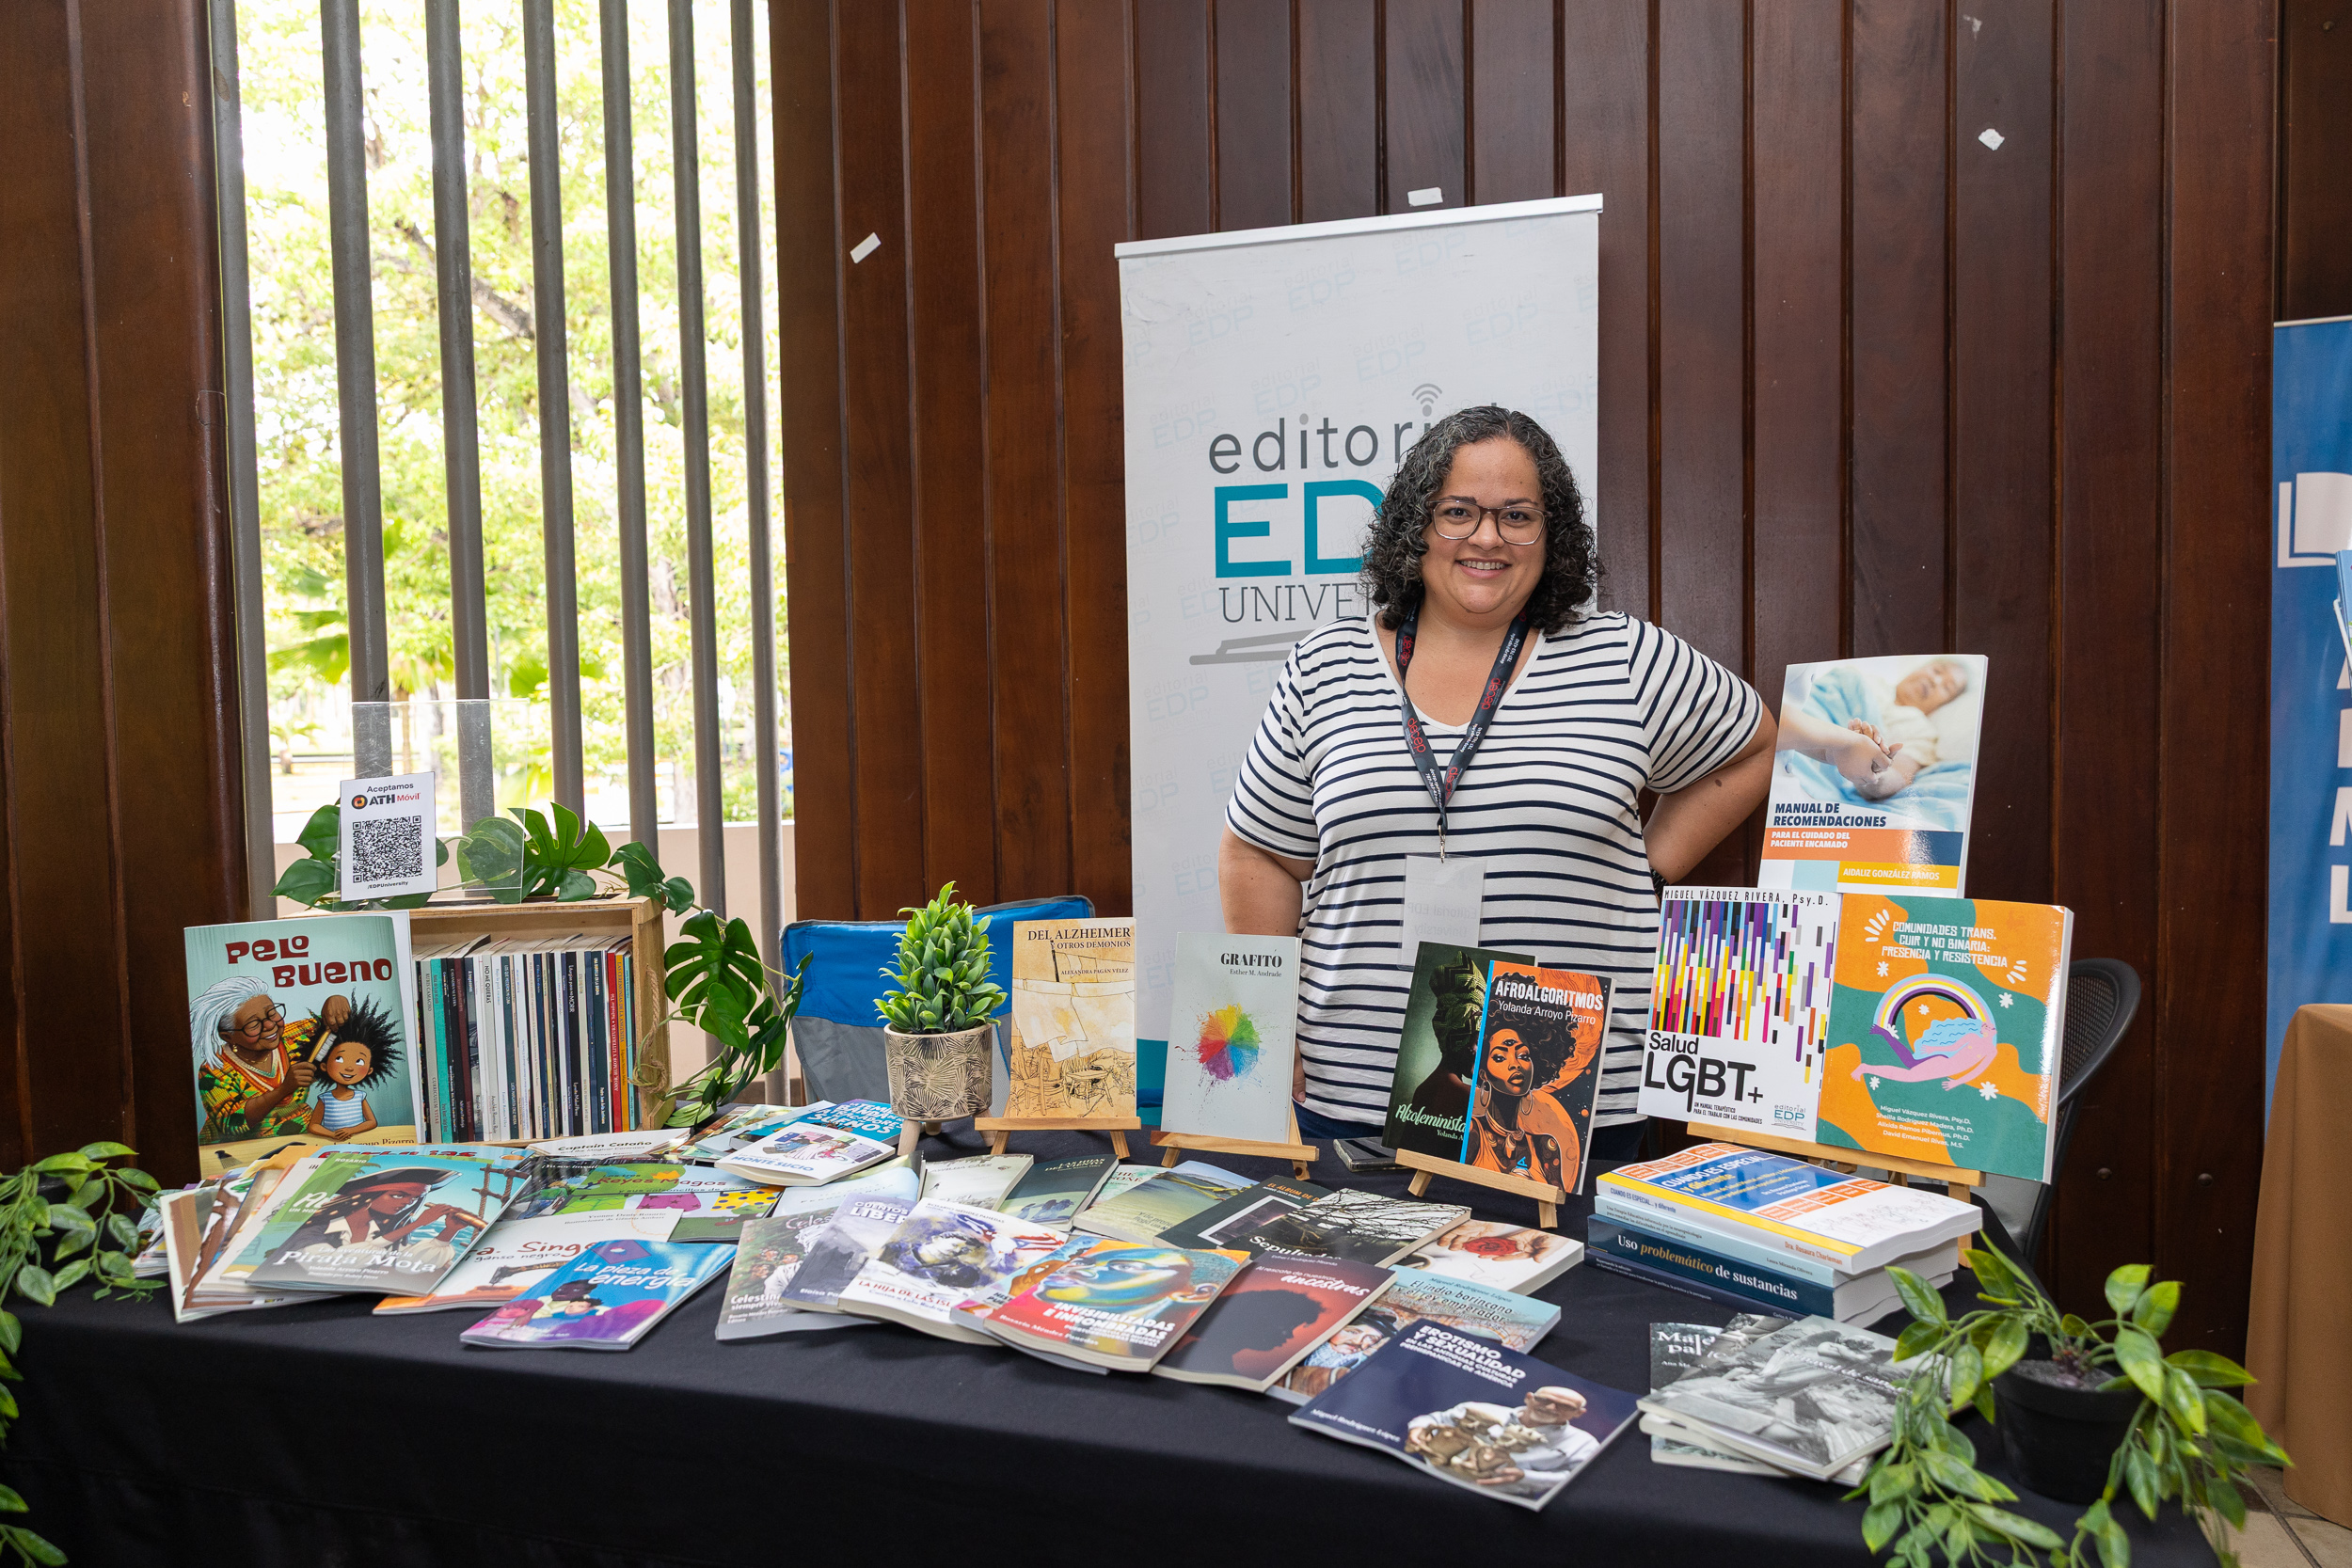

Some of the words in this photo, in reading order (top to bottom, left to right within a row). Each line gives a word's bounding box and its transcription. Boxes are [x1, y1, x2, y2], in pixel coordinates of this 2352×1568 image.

[1287, 269, 1356, 312] EDP
[1356, 340, 1426, 382] EDP
[1255, 374, 1321, 416] EDP
[1209, 404, 1444, 473] editori
[1215, 479, 1389, 578] ED
[1481, 677, 1501, 709] decep
[1147, 685, 1210, 723] EDP
[1407, 718, 1425, 752] decep
[367, 784, 414, 793] Aceptamos
[369, 794, 395, 805] ATH
[397, 793, 420, 801] Móvil
[1775, 803, 1822, 813] MANUAL
[1824, 803, 1839, 813] DE
[1773, 816, 1886, 827] RECOMENDACIONES
[1843, 868, 1871, 877] AIDALIZ
[1872, 868, 1910, 879] GONZÁLEZ
[1912, 871, 1939, 879] RAMOS
[1665, 890, 1693, 899] MIGUEL
[1700, 889, 1738, 901] VÁZQUEZ
[1028, 930, 1052, 940] DEL
[1056, 927, 1131, 939] ALZHEIMER
[1893, 922, 1957, 937] COMUNIDADES
[1899, 935, 1920, 946] CUIR
[1924, 937, 1929, 946] Y
[1931, 939, 1945, 948] NO
[1947, 940, 1990, 952] BINARIA:
[1882, 946, 1931, 960] PRESENCIA
[1934, 951, 1940, 960] Y
[1943, 951, 2008, 968] RESISTENCIA
[485, 965, 489, 974] NO
[1495, 980, 1603, 1011] AFROALGORITMOS
[1498, 1000, 1533, 1015] Yolanda
[1534, 1006, 1563, 1021] Arroyo
[1565, 1010, 1596, 1024] Pizarro
[1649, 1032, 1699, 1054] Salud
[1714, 1104, 1736, 1113] TERAPÉUTICO
[1774, 1104, 1805, 1113] editorial
[1774, 1110, 1804, 1121] EDP
[1902, 1108, 1928, 1117] Vázquez
[807, 1114, 892, 1133] SUEÑOS
[1739, 1116, 1763, 1124] COMUNIDADES
[1897, 1116, 1929, 1126] Rodríguez
[1437, 1130, 1457, 1139] Yolanda
[1901, 1133, 1930, 1142] Emanuel
[558, 1143, 604, 1151] Captain
[731, 1156, 772, 1166] MONTE
[776, 1160, 814, 1172] SUCIO
[597, 1177, 653, 1185] Reyes
[1661, 1169, 1707, 1187] CUANDO
[1708, 1164, 1721, 1176] ES
[1689, 1174, 1737, 1190] diferente
[1277, 1185, 1301, 1196] ÁLBUM
[1610, 1187, 1626, 1196] CUANDO
[854, 1201, 908, 1214] CUENTOS
[336, 1247, 388, 1256] aventuras
[475, 1254, 515, 1262] ganso
[1795, 1244, 1815, 1256] Rosaura
[273, 1251, 356, 1267] Pirata
[370, 1254, 437, 1273] Mota
[575, 1262, 595, 1273] La
[601, 1265, 651, 1275] pieza
[652, 1264, 678, 1275] de
[1618, 1234, 1638, 1250] Uso
[1640, 1243, 1713, 1275] problemático
[1715, 1265, 1730, 1278] de
[1732, 1272, 1798, 1300] sustancias
[588, 1273, 695, 1290] energía
[1281, 1275, 1370, 1296] ancestras
[872, 1283, 898, 1293] HIJA
[899, 1287, 914, 1296] DE
[915, 1291, 933, 1302] LAS
[1421, 1291, 1438, 1301] rey
[1423, 1282, 1453, 1295] indio
[1454, 1291, 1513, 1314] borincano
[1043, 1308, 1053, 1317] E
[1055, 1310, 1168, 1339] INNOMBRADAS
[1054, 1302, 1176, 1332] INVISIBILIZADAS
[1419, 1325, 1502, 1359] EROTISMO
[1414, 1331, 1425, 1340] Y
[1425, 1336, 1526, 1379] SEXUALIDAD
[1418, 1340, 1433, 1350] LAS
[1434, 1345, 1474, 1366] ANTIGUAS
[1475, 1362, 1518, 1384] CULTURAS
[1311, 1408, 1337, 1422] Miguel
[1338, 1415, 1376, 1434] Rodríguez
[1376, 1428, 1401, 1443] López
